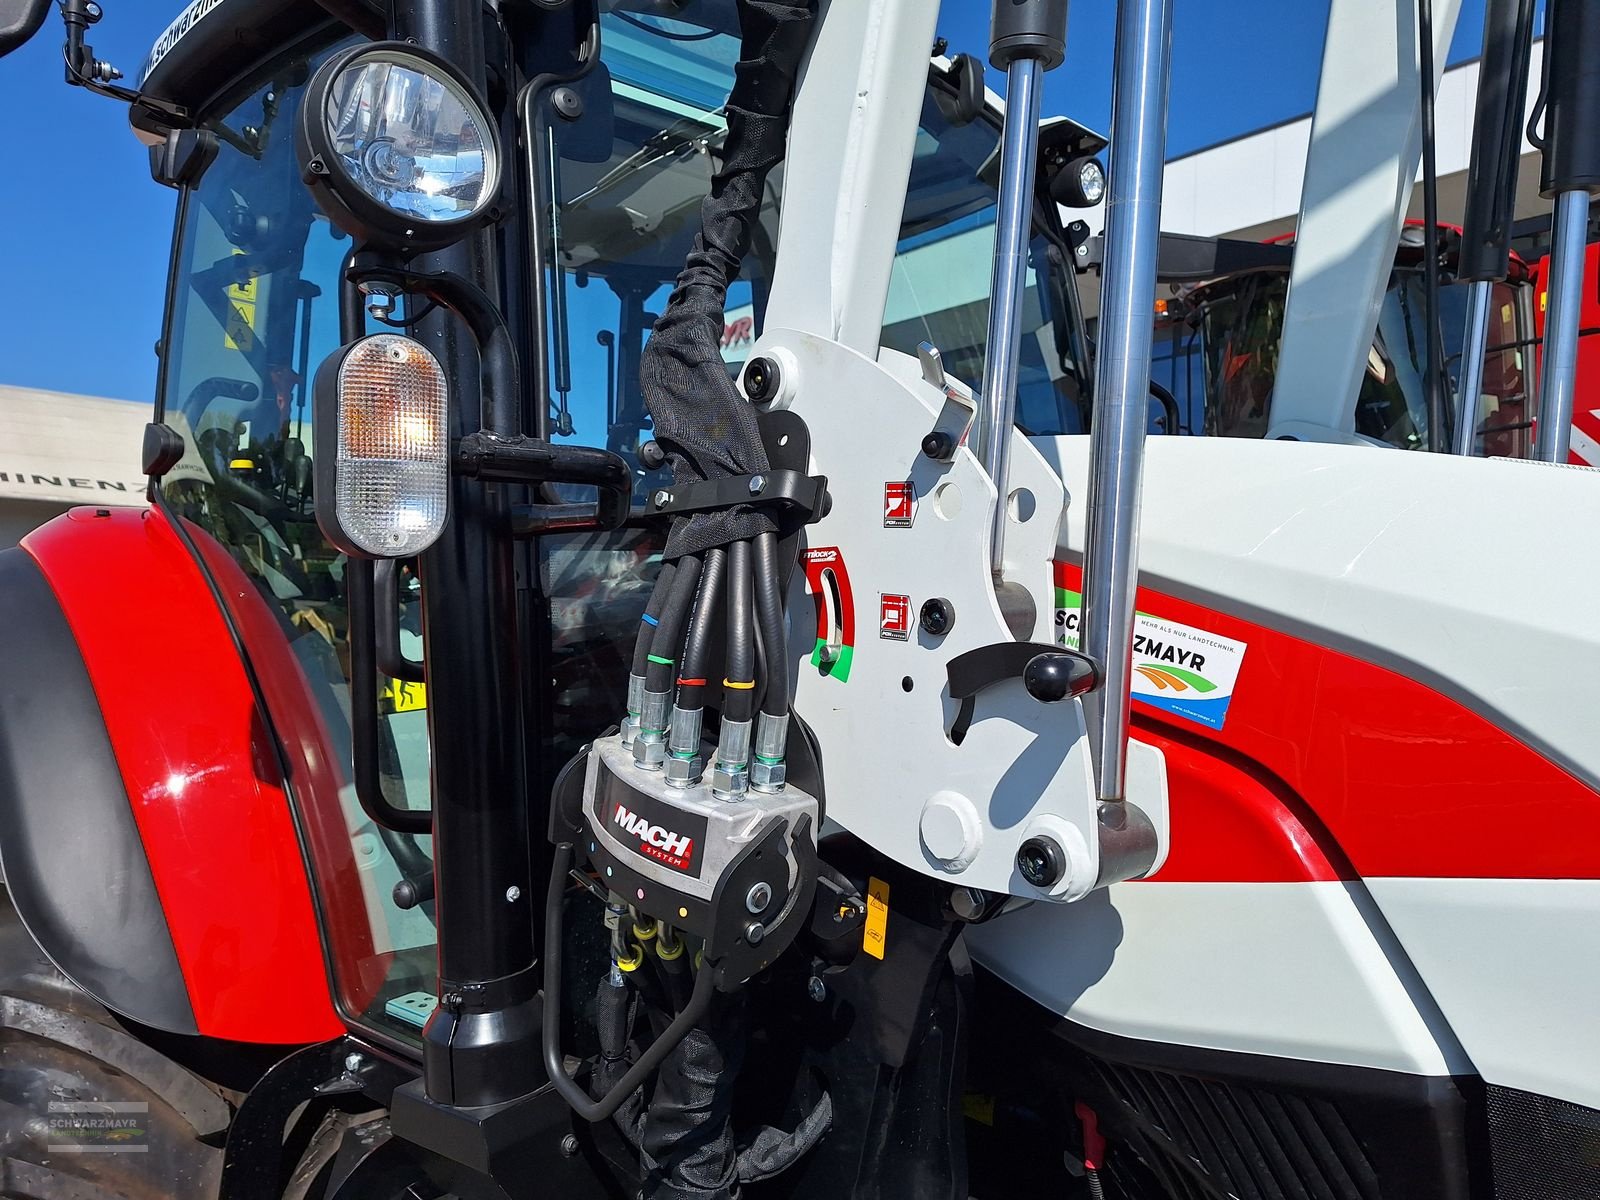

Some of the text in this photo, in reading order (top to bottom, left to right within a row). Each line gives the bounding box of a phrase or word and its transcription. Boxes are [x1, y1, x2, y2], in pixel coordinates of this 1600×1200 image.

[1141, 620, 1158, 629] MEHR
[1159, 625, 1172, 633] ALS
[614, 805, 691, 857] MACH
[646, 847, 682, 866] SYSTEM
